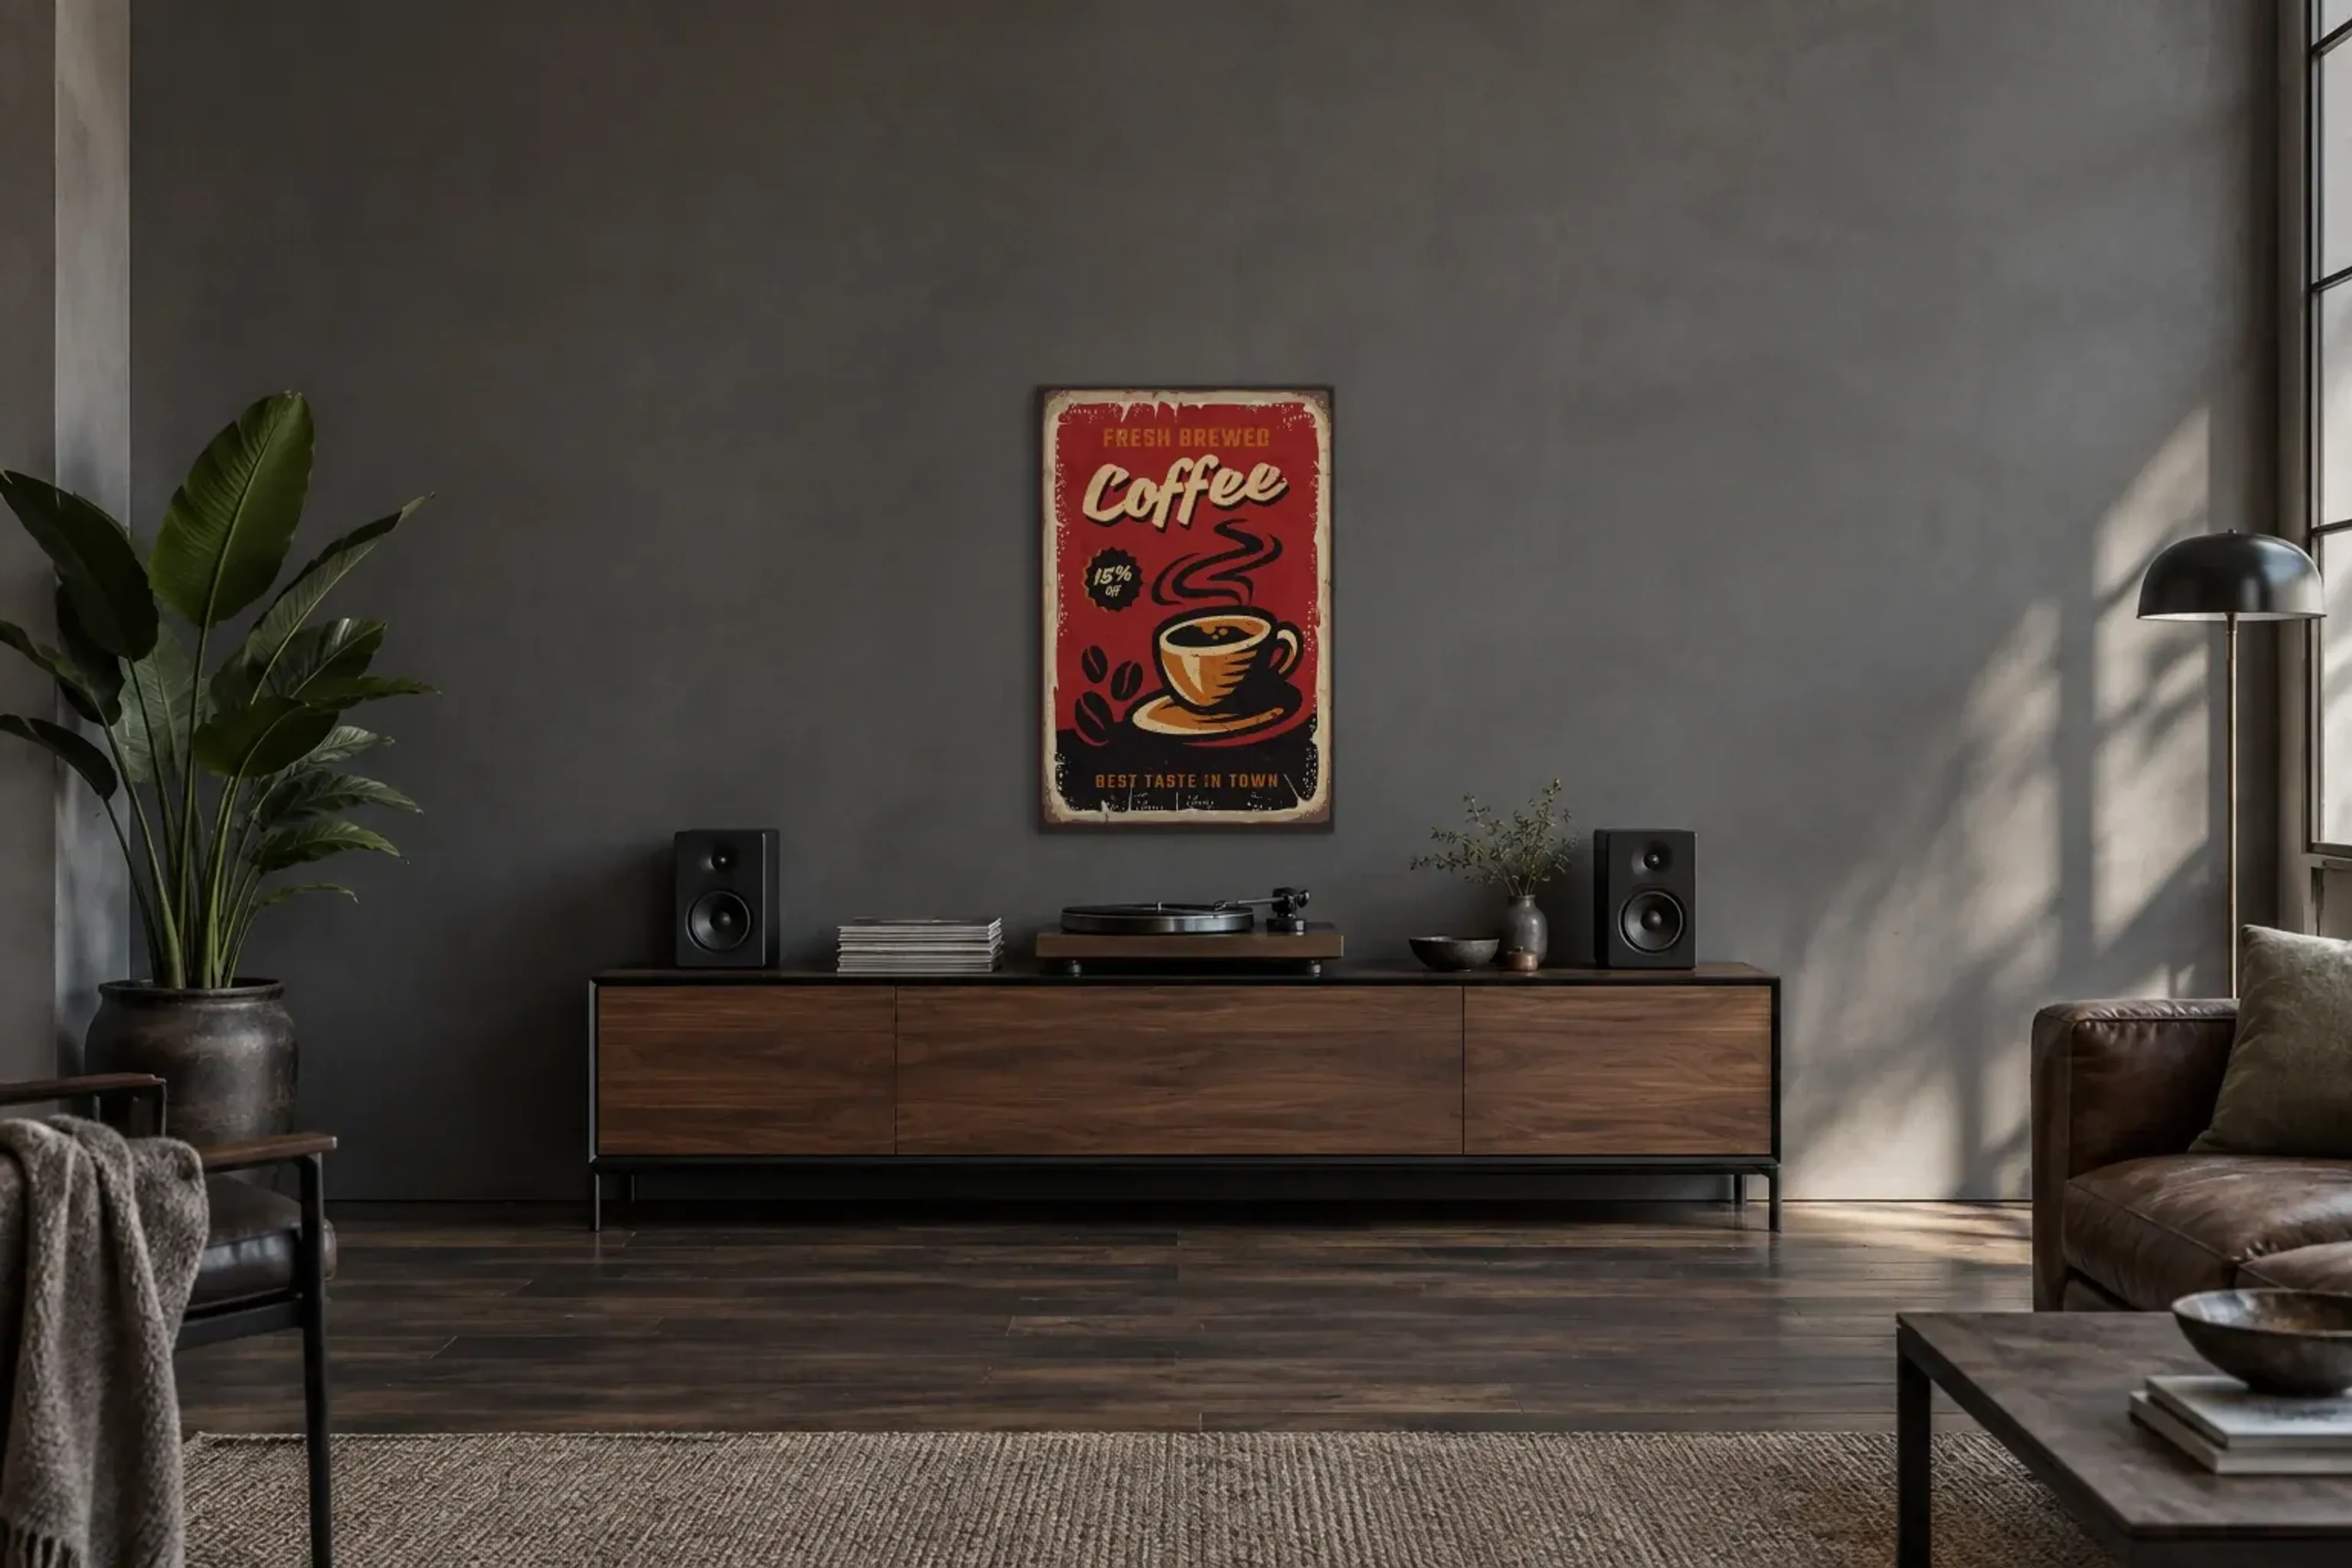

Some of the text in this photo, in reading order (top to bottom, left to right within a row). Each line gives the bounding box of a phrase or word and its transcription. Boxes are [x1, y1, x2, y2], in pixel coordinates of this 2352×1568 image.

[1103, 428, 1270, 447] FRESH BREWED
[1082, 454, 1289, 531] Coffee
[1093, 564, 1133, 586] 15%
[1095, 774, 1279, 788] BEST TASTE IN TOWN
